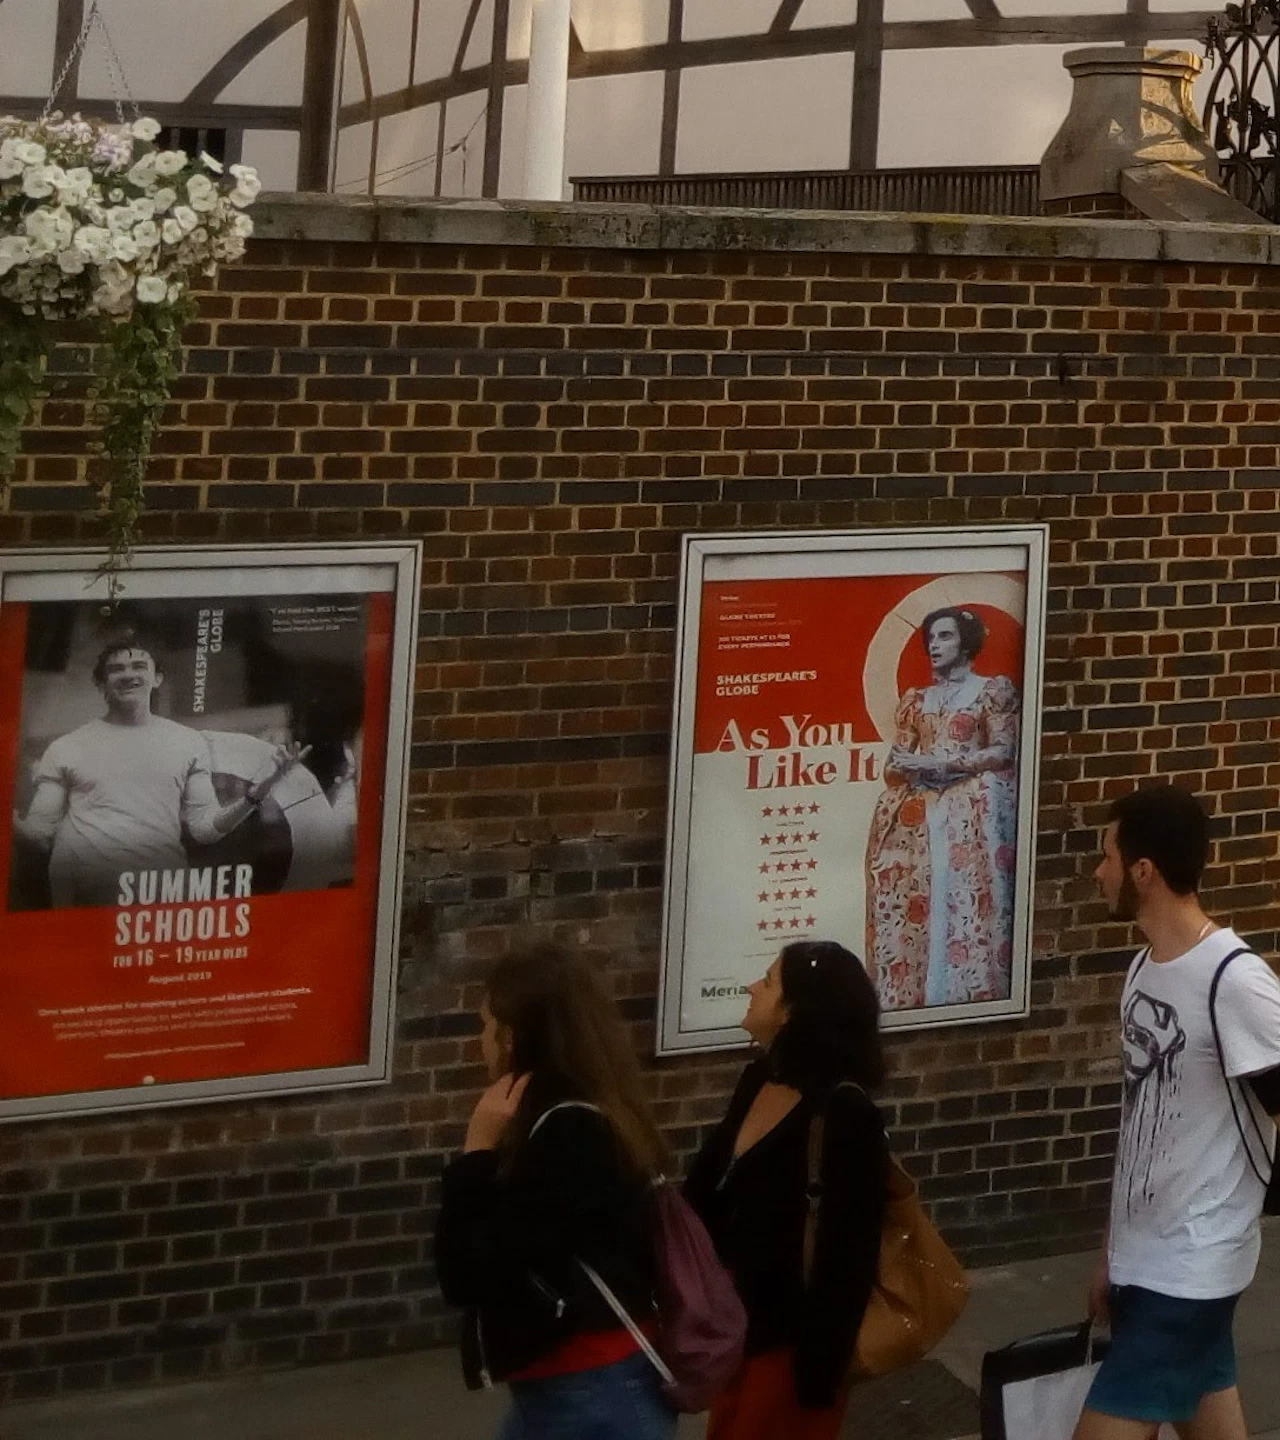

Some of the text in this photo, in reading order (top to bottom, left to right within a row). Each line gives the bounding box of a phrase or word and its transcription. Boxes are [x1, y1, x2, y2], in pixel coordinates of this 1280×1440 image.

[209, 608, 225, 653] GLOBE
[192, 609, 210, 713] SHAKESPEARE'S
[716, 669, 818, 685] SHAKESPEARE'S
[715, 684, 760, 696] GLOBE
[716, 713, 854, 753] As You
[745, 748, 880, 790] Like It
[117, 863, 254, 907] SUMMER
[114, 903, 251, 946] SCHOOLS
[137, 948, 154, 967] 16
[175, 946, 194, 963] 19
[700, 984, 751, 998] Meria
